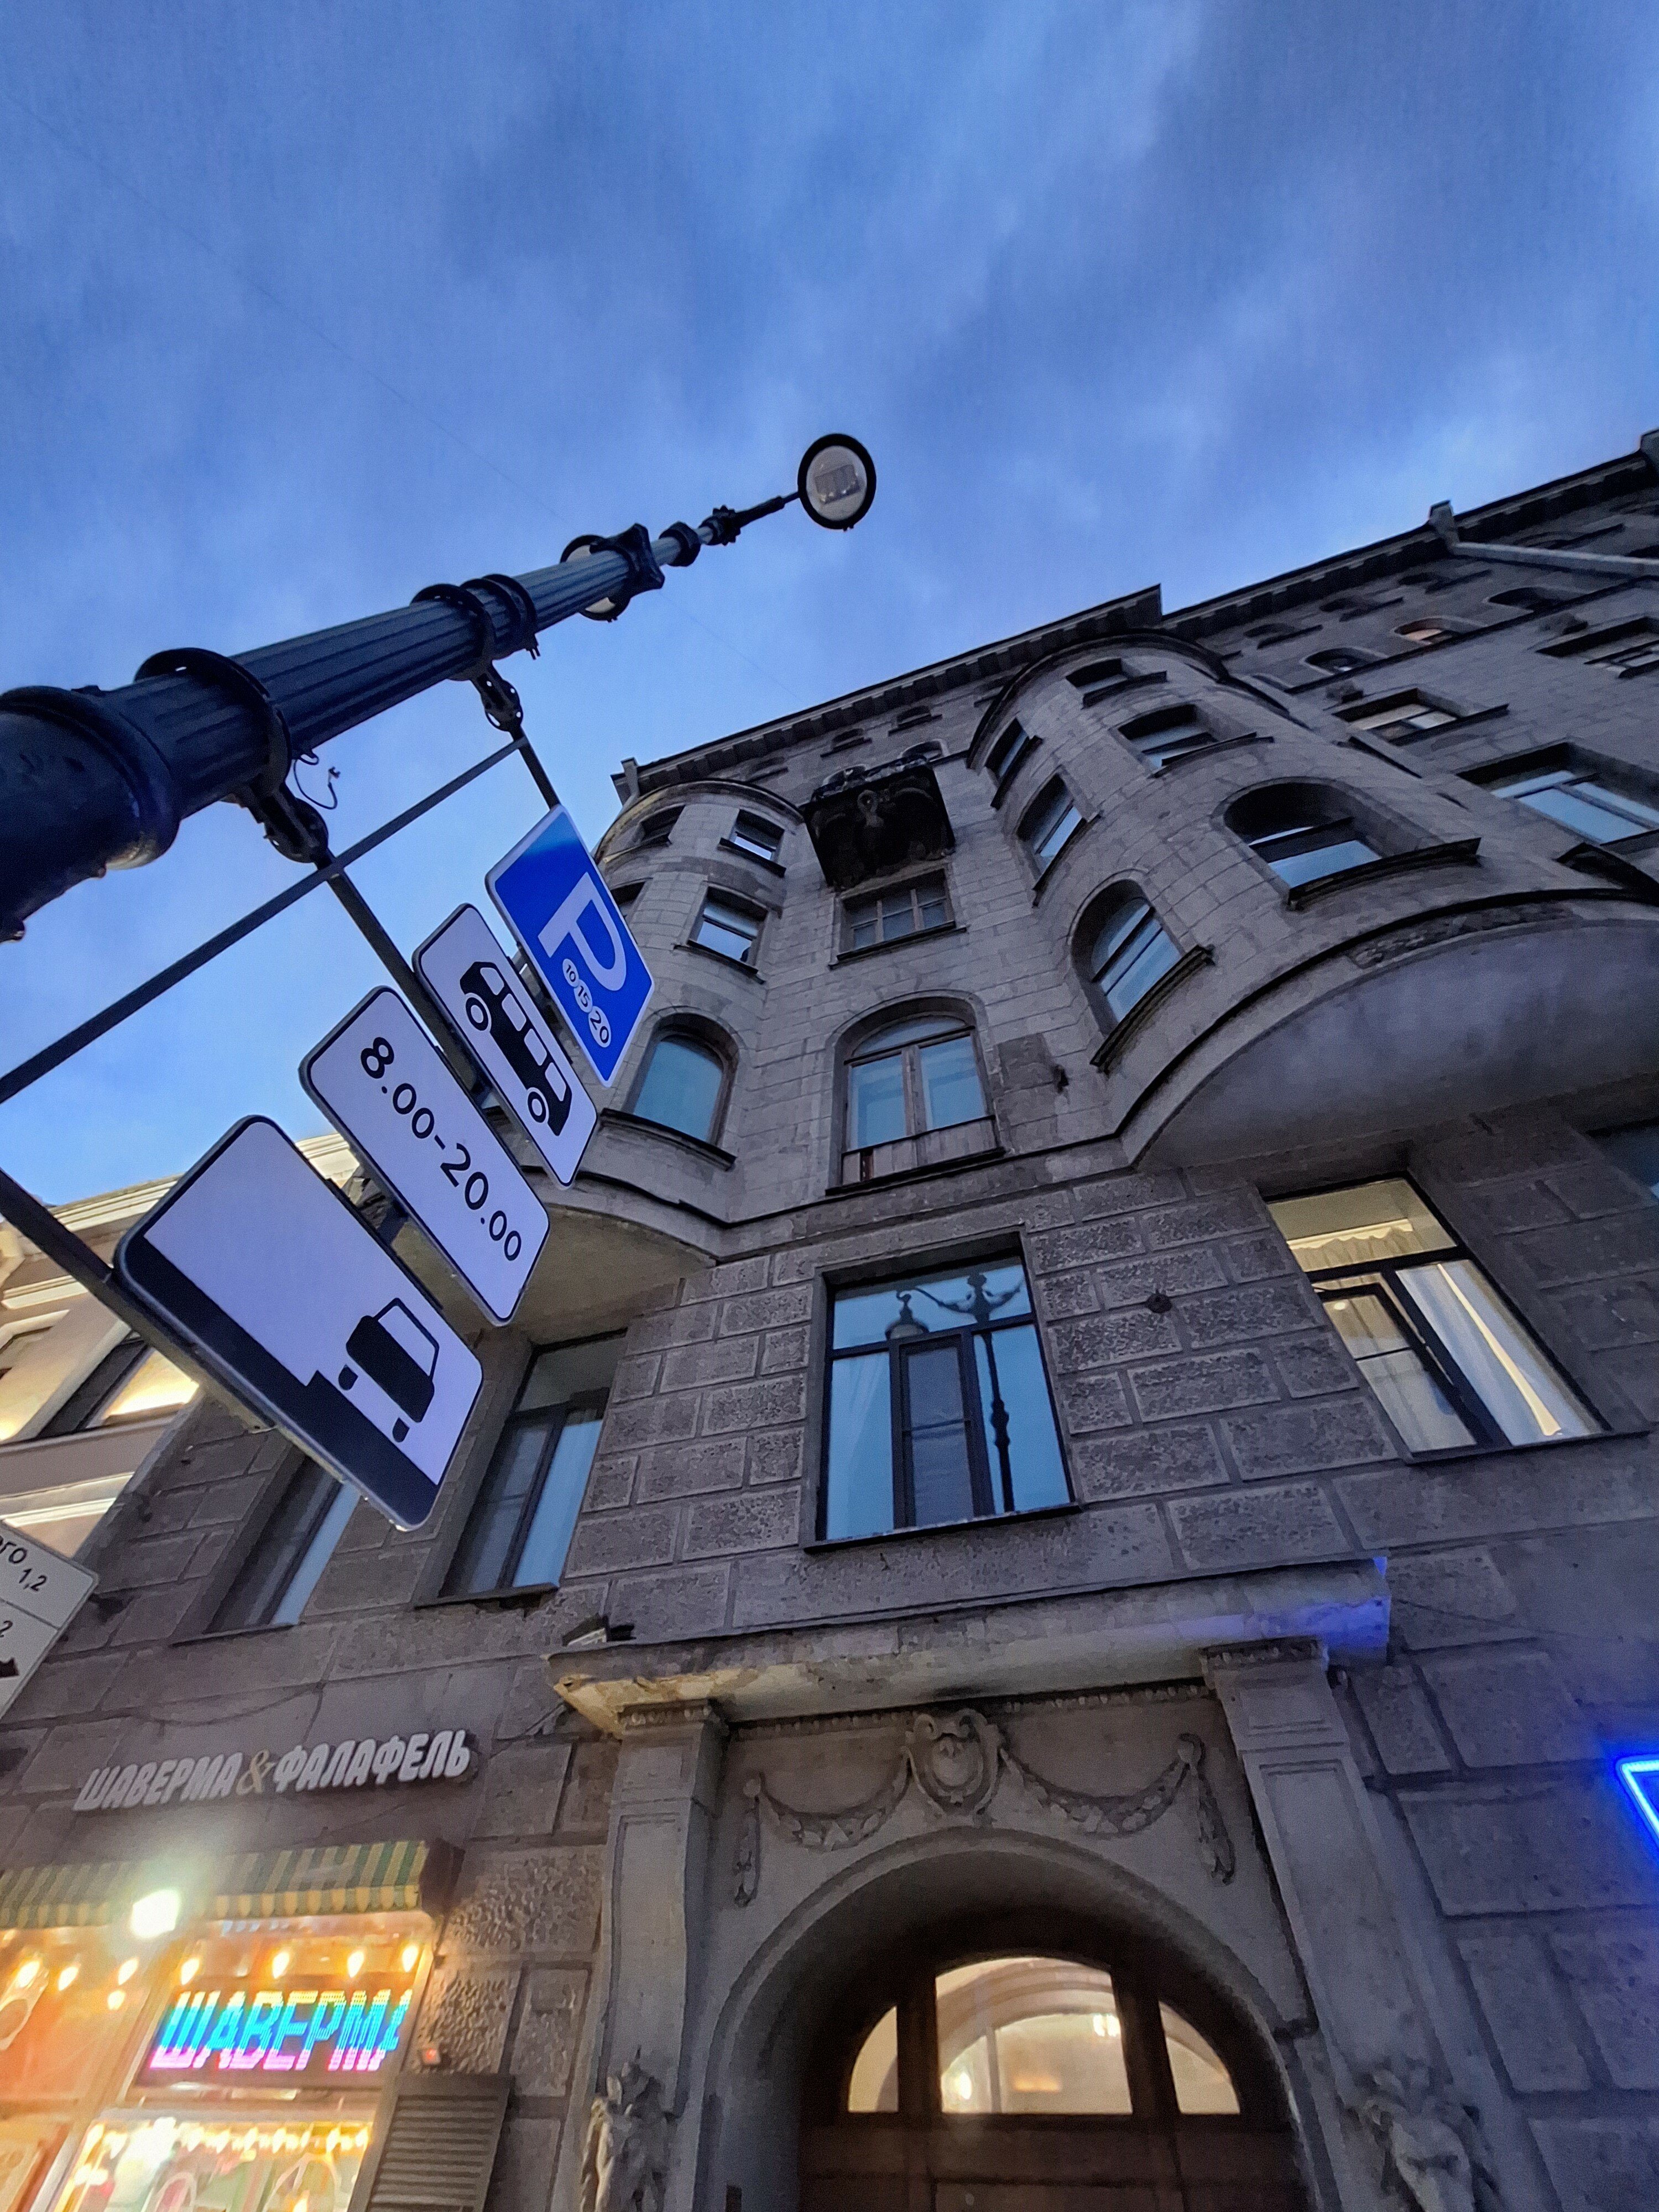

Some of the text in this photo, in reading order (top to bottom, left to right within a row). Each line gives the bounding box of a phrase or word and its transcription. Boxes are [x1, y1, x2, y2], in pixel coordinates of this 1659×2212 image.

[537, 871, 627, 991] P
[566, 964, 609, 1044] 10 15 20
[360, 1036, 522, 1261] 8.00-20.00
[18, 1568, 47, 1592] 1,2
[72, 1751, 243, 1811] ШАВЕРМА
[273, 1729, 471, 1793] ФАЛАФЕЛЬ
